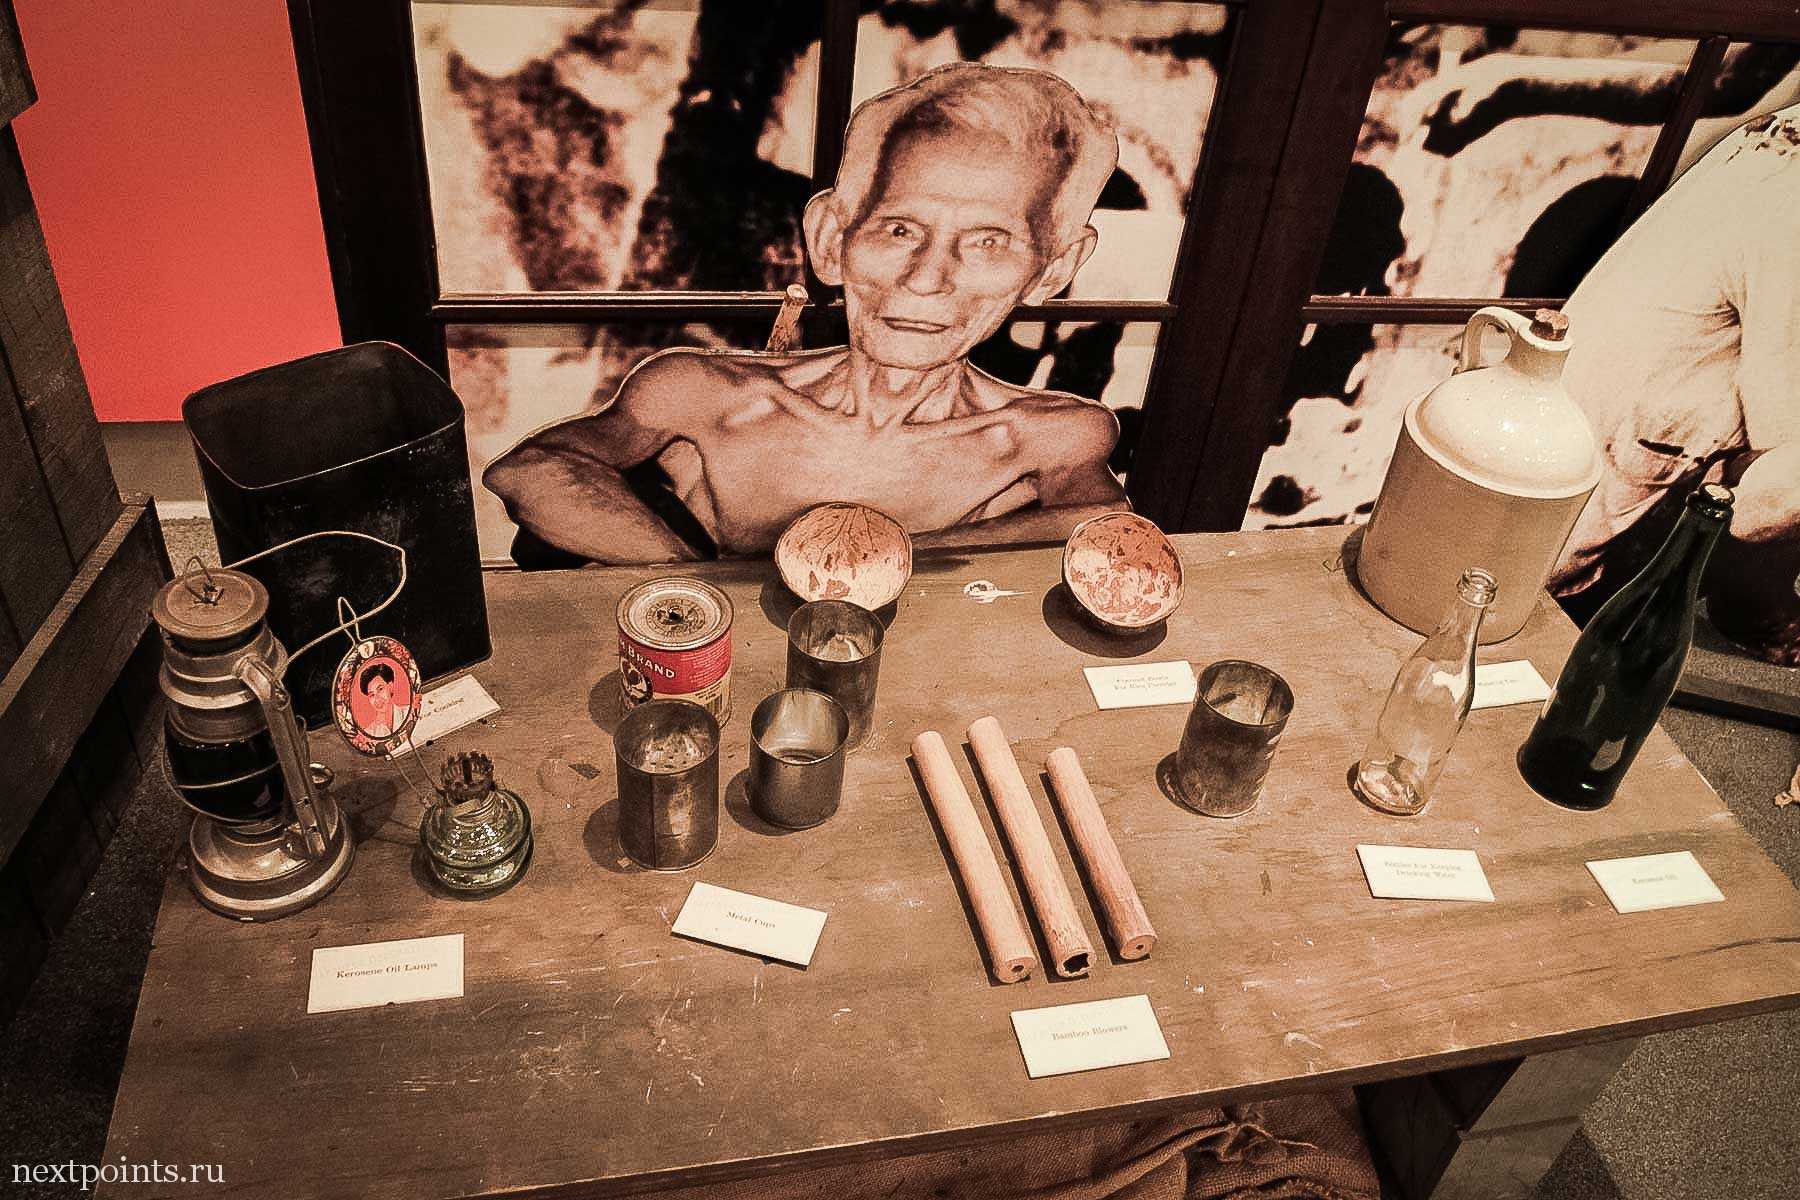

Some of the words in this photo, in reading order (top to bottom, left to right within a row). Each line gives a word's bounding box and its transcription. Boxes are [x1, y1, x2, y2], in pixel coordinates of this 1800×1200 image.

[627, 645, 676, 679] BRAND
[726, 911, 753, 923] Metal
[336, 967, 383, 979] Kerosene
[386, 965, 401, 974] Oil
[404, 962, 438, 973] Lamps
[1051, 1029, 1090, 1041] Bamboo
[1092, 1024, 1128, 1036] Blowers
